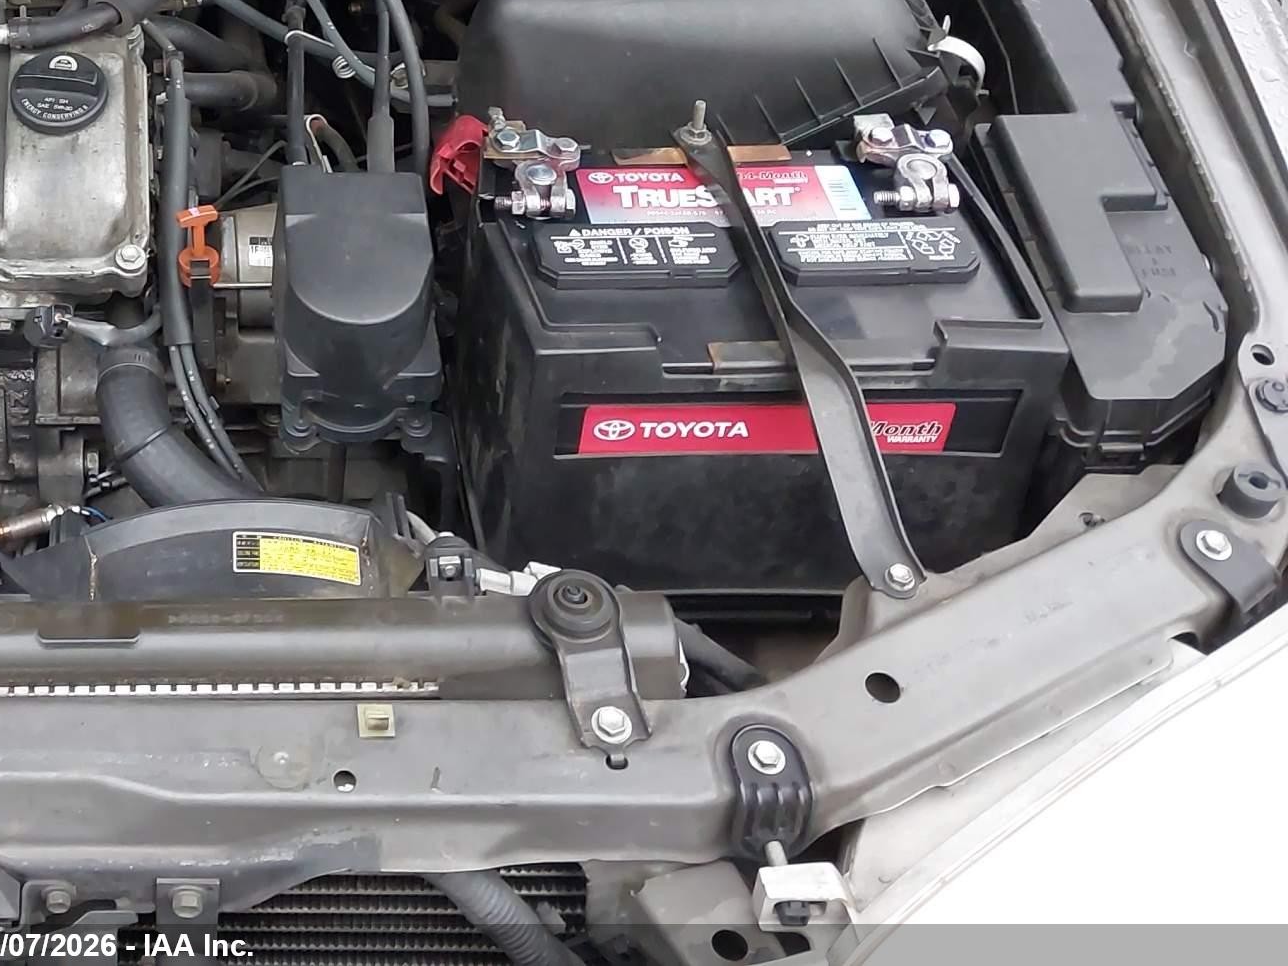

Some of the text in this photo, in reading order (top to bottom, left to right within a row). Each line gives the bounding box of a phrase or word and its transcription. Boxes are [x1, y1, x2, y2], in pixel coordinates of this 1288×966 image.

[21, 98, 42, 115] ENERGY
[42, 106, 83, 120] CONSERVING
[614, 172, 685, 183] TOYOTA
[612, 185, 795, 209] TRUESART
[582, 228, 633, 237] DANGER
[644, 227, 690, 236] POISON
[640, 420, 749, 439] TOYOTA
[886, 434, 938, 444] WARRANTY
